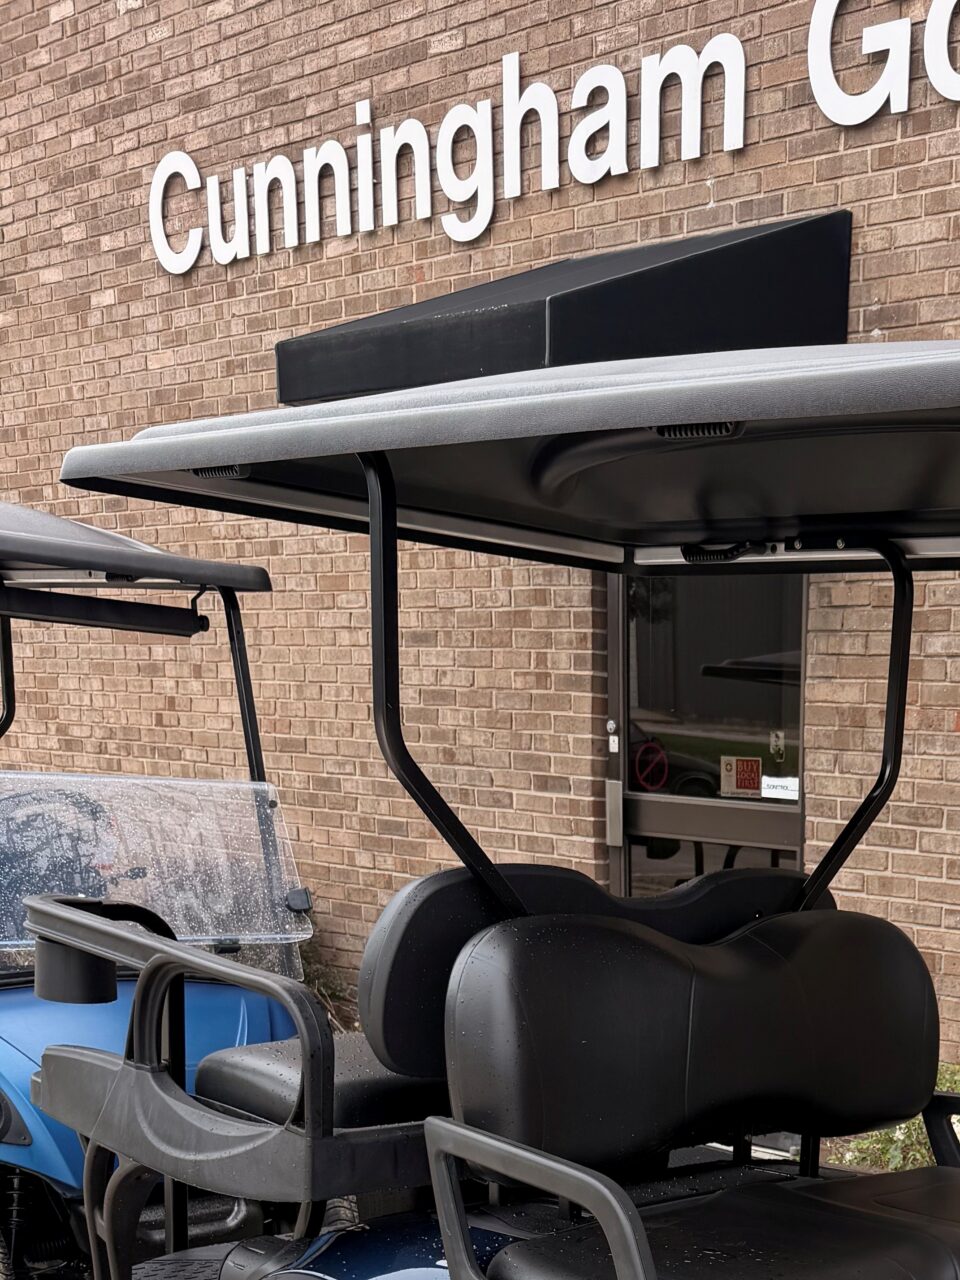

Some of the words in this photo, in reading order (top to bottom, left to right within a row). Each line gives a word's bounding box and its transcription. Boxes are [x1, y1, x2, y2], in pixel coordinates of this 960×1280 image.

[149, 33, 747, 275] Cunningham
[737, 760, 759, 772] BUY
[737, 771, 759, 780] LOCAL
[737, 779, 759, 789] FIRST
